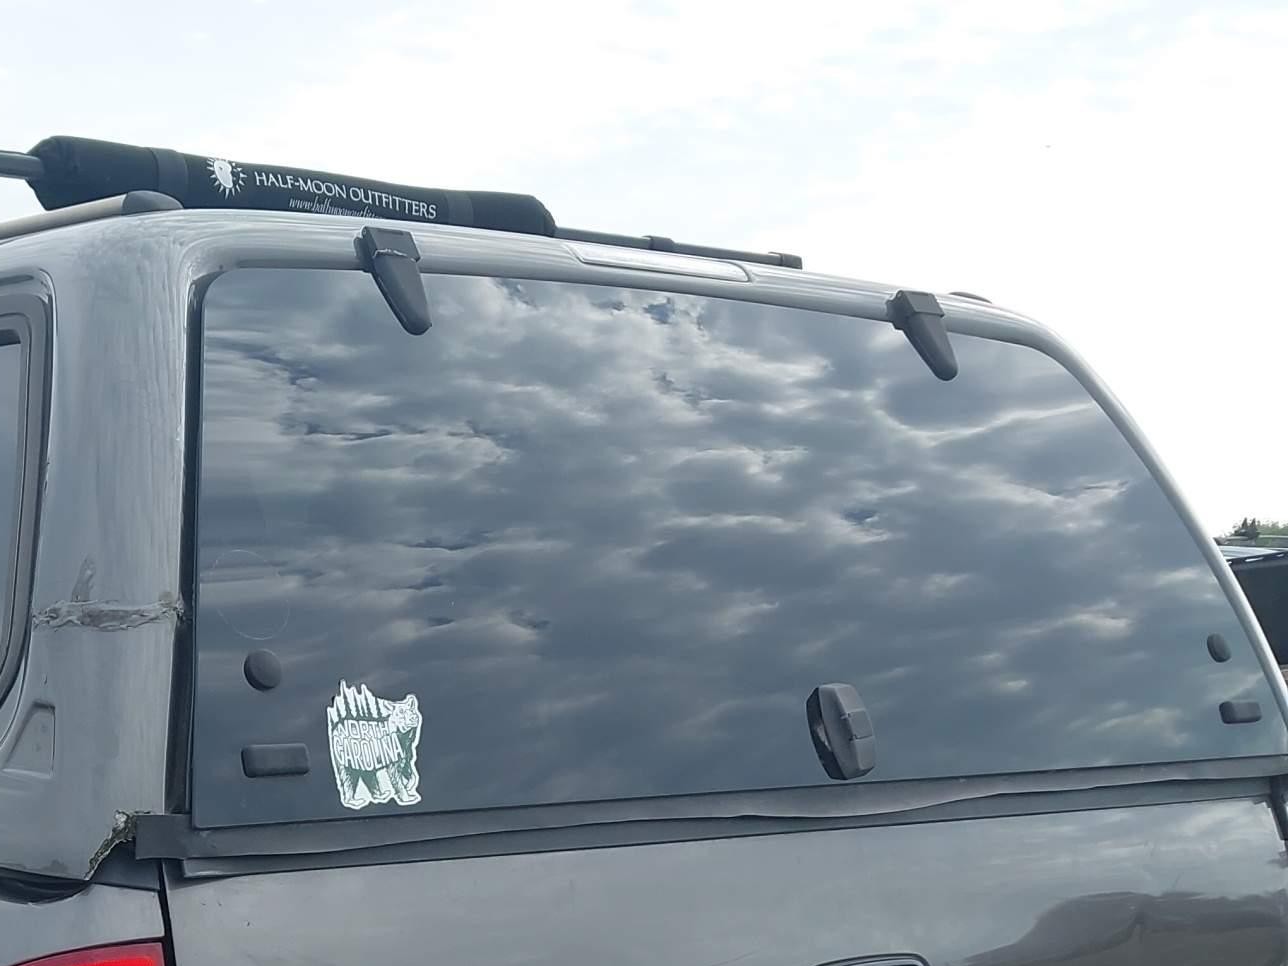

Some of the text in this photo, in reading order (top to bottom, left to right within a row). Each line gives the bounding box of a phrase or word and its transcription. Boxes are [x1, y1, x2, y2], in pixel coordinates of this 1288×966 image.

[255, 171, 437, 219] HALF-MOON OUTFITTERS
[333, 719, 390, 742] NORTH
[333, 732, 405, 771] CAROLINA
